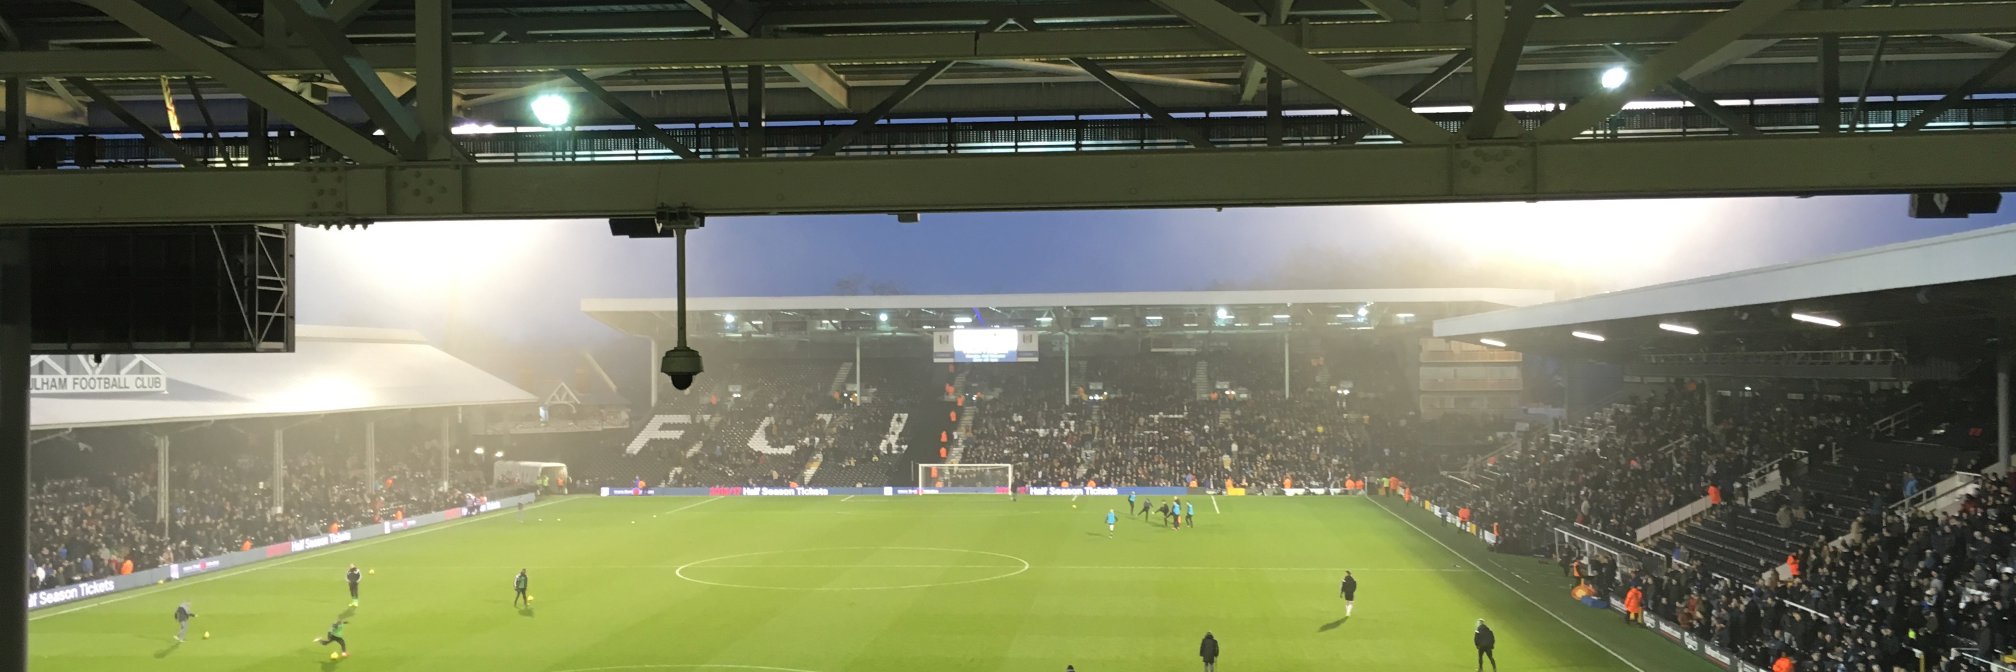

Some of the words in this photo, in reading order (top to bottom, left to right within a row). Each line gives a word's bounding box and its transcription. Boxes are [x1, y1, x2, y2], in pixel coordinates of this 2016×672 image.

[30, 377, 68, 391] ULHAM
[72, 377, 130, 390] FOOTBALL
[134, 376, 162, 389] CLUB
[761, 487, 795, 496] Season
[795, 487, 829, 496] Tickets
[1048, 486, 1083, 496] Season
[39, 587, 78, 606] Season
[78, 580, 115, 597] Tickets
